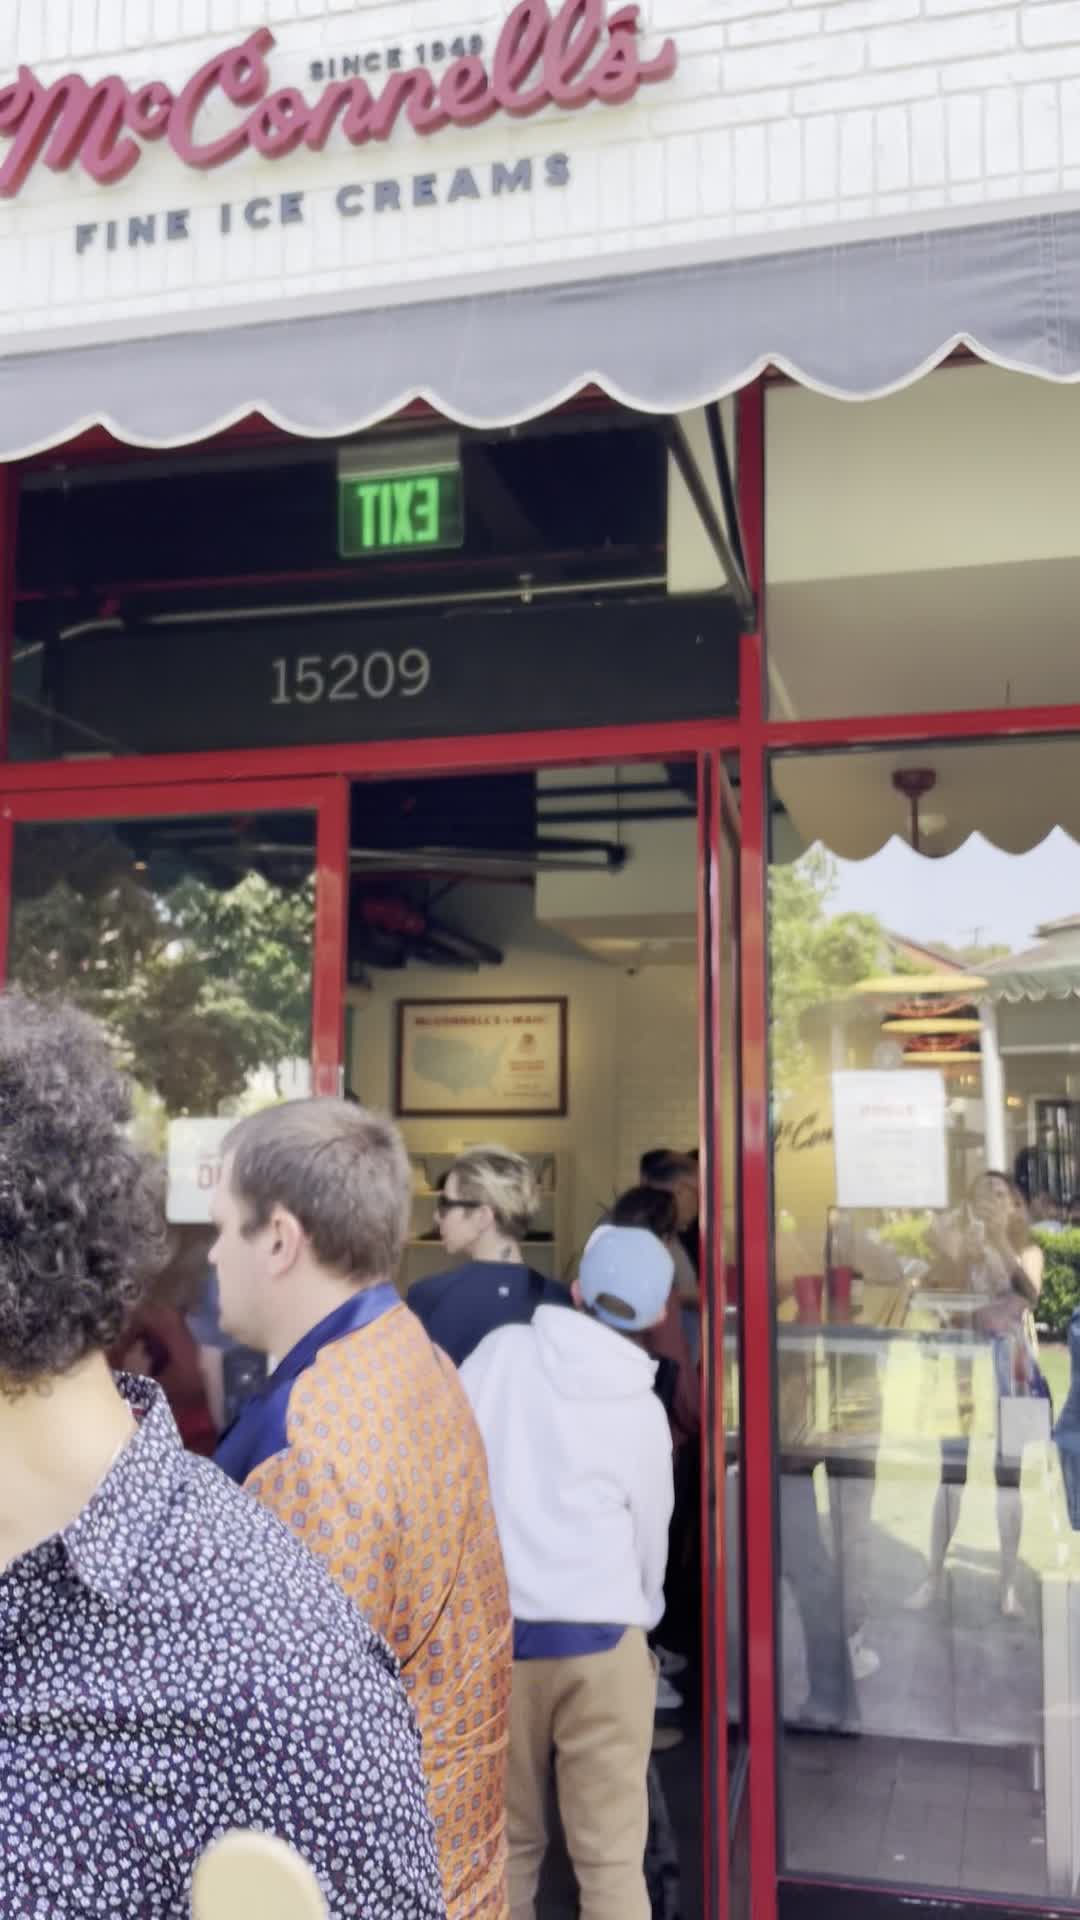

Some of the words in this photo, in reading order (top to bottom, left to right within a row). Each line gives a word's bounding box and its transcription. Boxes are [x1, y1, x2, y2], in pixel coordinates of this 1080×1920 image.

[310, 48, 401, 82] SINCE
[76, 208, 190, 254] FINE
[221, 191, 304, 235] ICE
[335, 152, 571, 217] CREAMS
[271, 648, 430, 704] 15209
